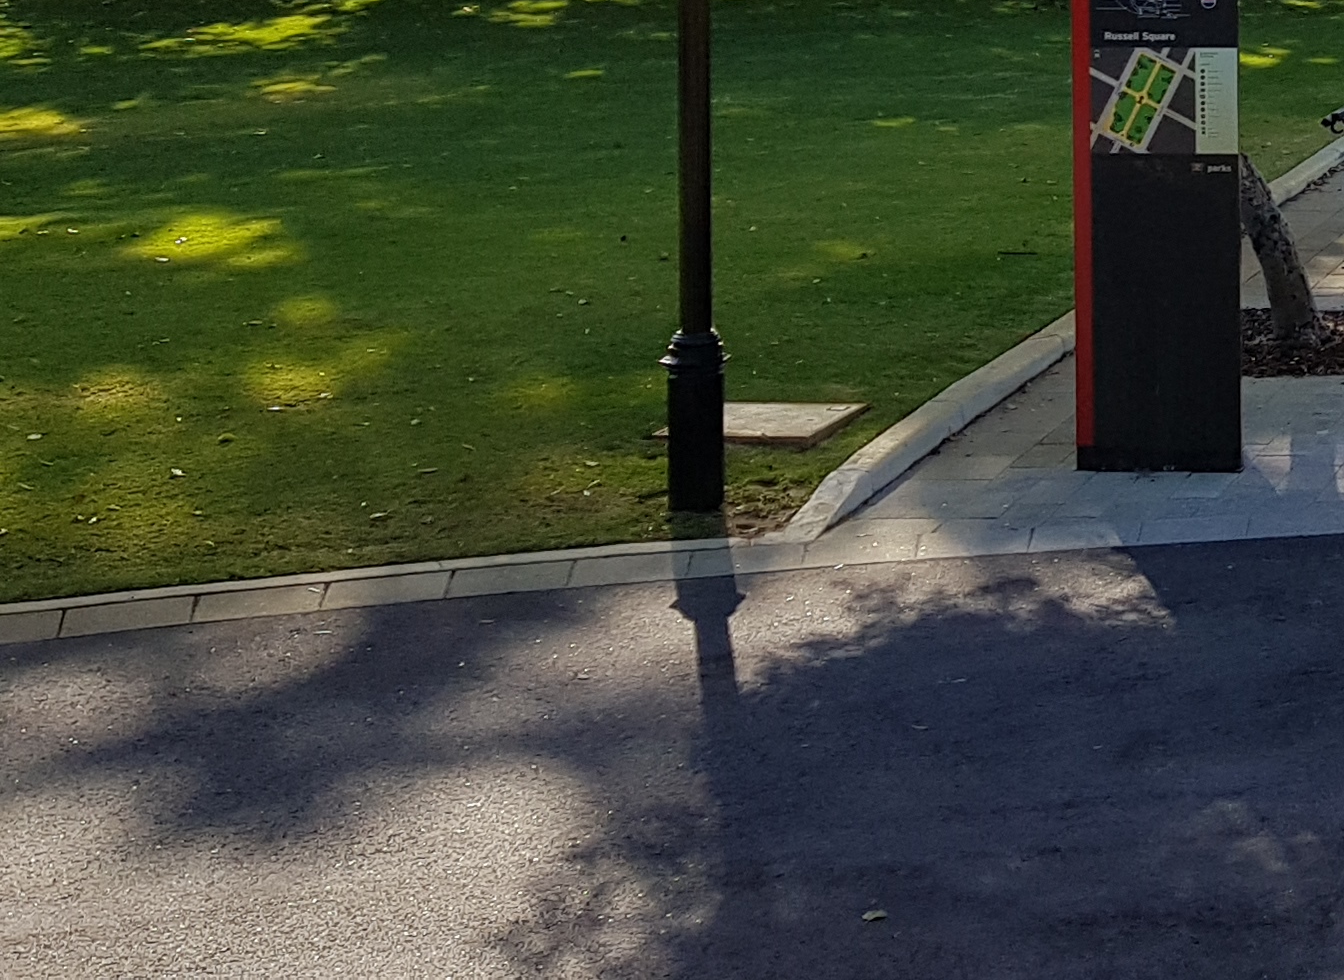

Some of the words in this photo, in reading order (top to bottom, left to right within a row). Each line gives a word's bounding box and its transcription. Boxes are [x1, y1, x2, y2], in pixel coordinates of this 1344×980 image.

[1104, 31, 1140, 41] Russell
[1142, 31, 1176, 43] Square
[1207, 164, 1232, 174] parks
